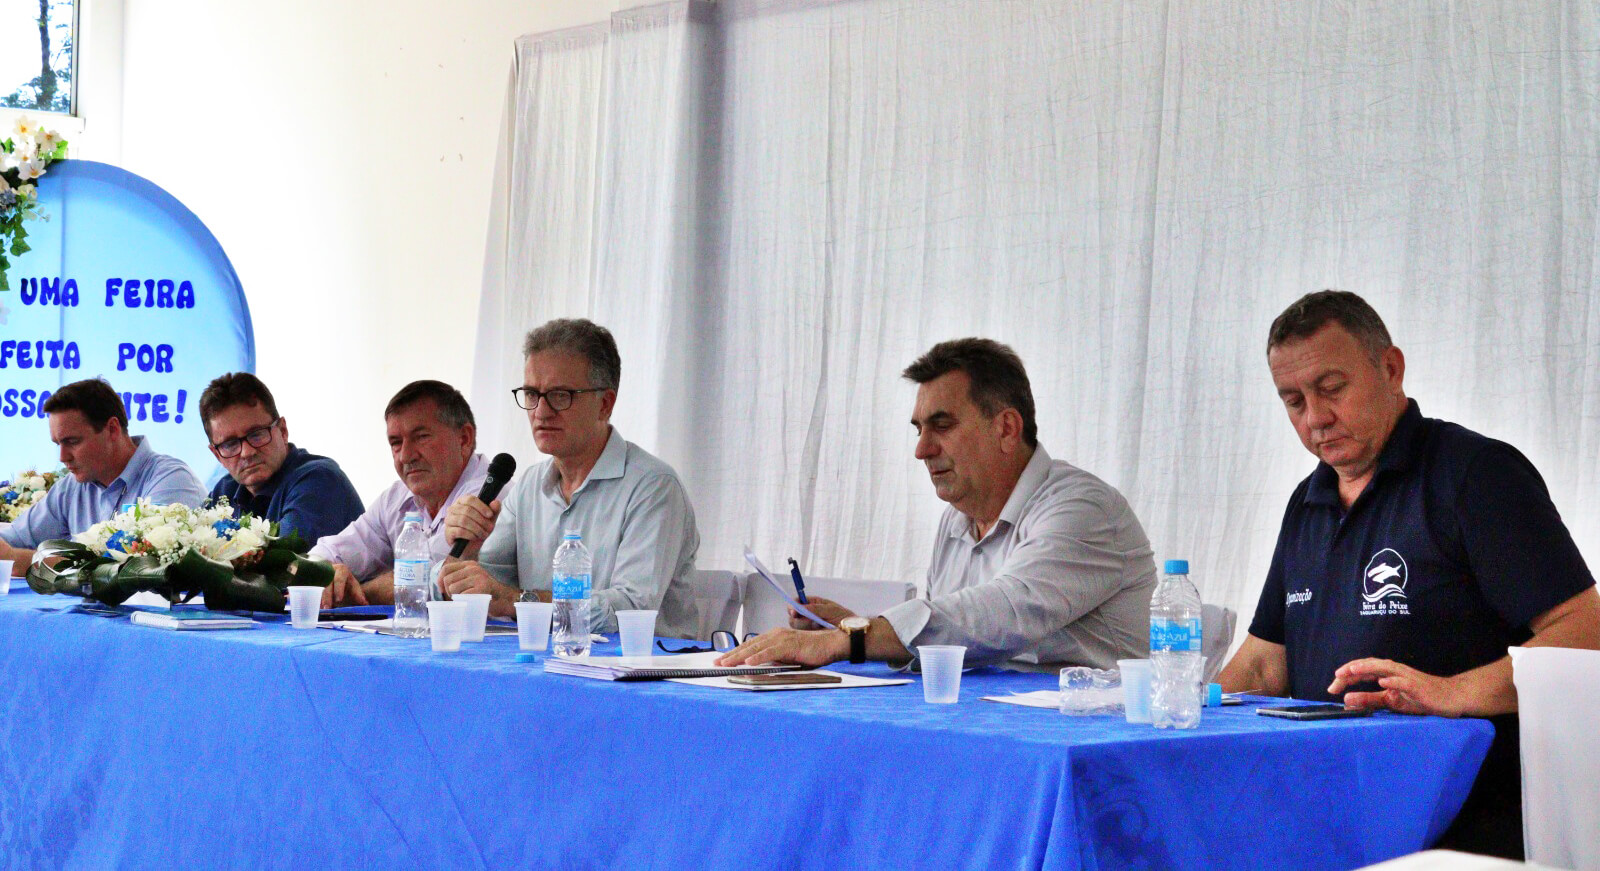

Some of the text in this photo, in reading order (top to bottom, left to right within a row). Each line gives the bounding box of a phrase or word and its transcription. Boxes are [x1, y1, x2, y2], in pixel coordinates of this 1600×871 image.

[20, 276, 195, 309] UMA FEIRA
[0, 340, 174, 373] FEITA POR
[1379, 600, 1387, 610] do
[1389, 600, 1408, 610] Peixe
